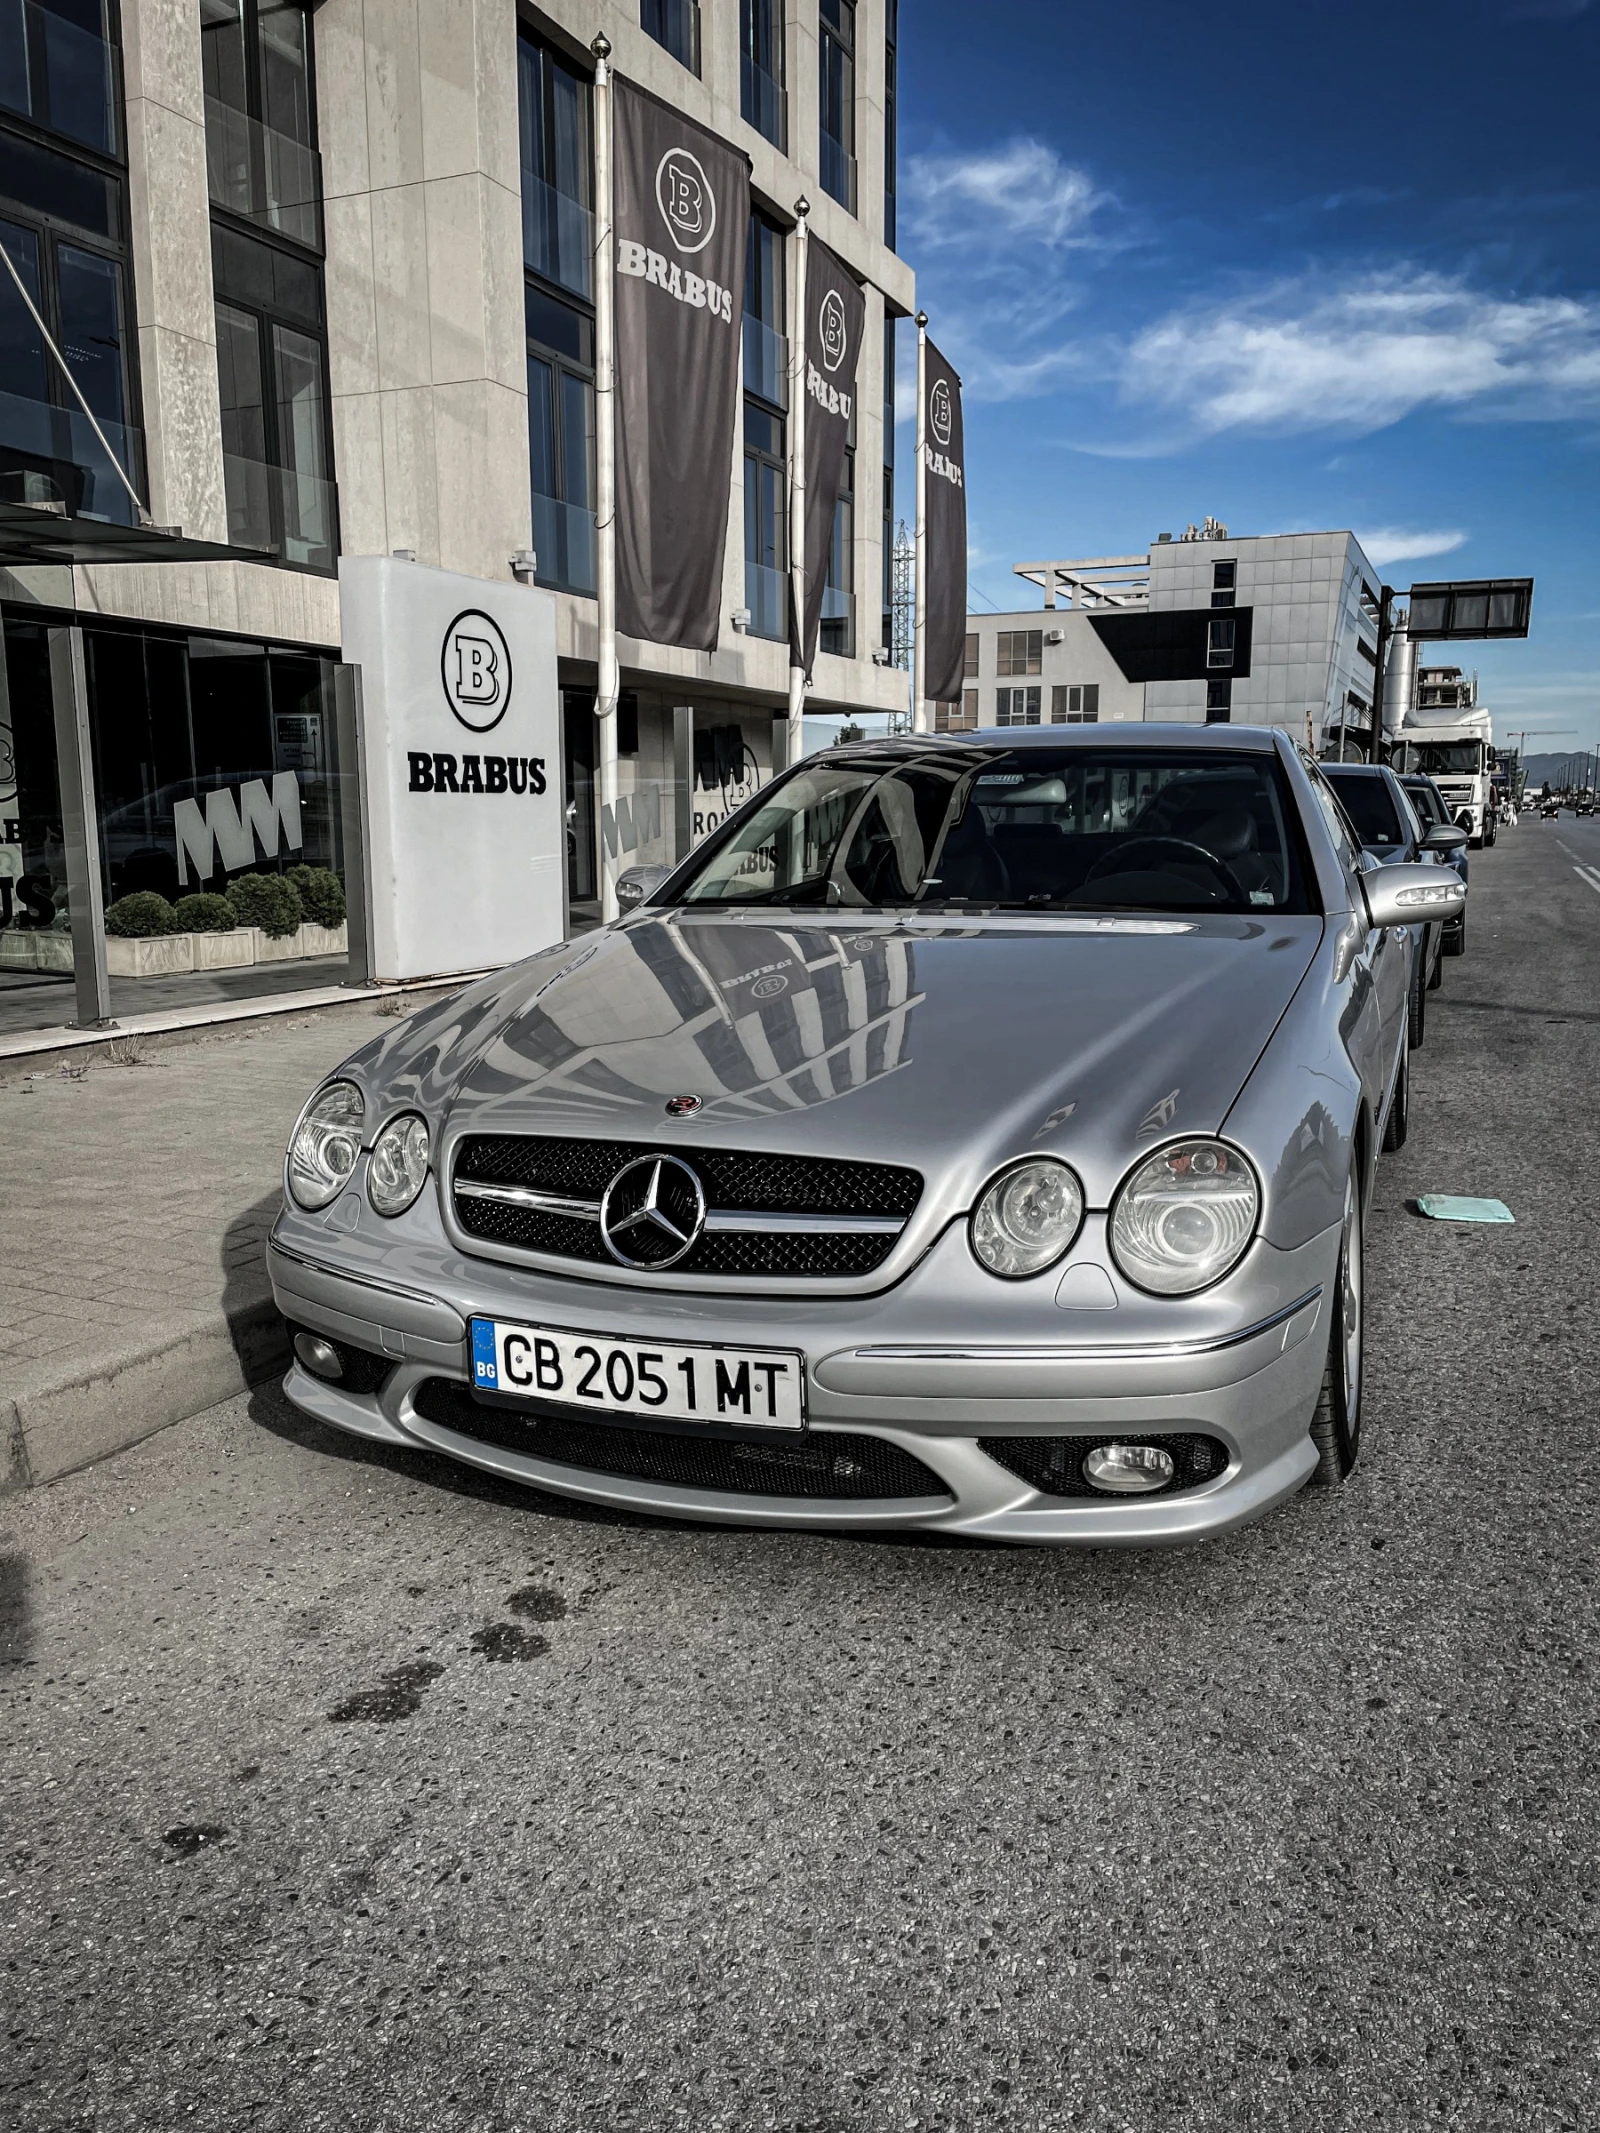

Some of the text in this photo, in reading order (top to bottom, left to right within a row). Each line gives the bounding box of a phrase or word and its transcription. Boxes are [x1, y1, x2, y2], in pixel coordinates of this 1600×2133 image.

[668, 164, 702, 233] B
[617, 239, 733, 325] BRABUS
[455, 634, 500, 706] B
[407, 751, 547, 795] BRABUS
[477, 1361, 496, 1379] BG
[503, 1333, 789, 1418] CB 2051 MT
